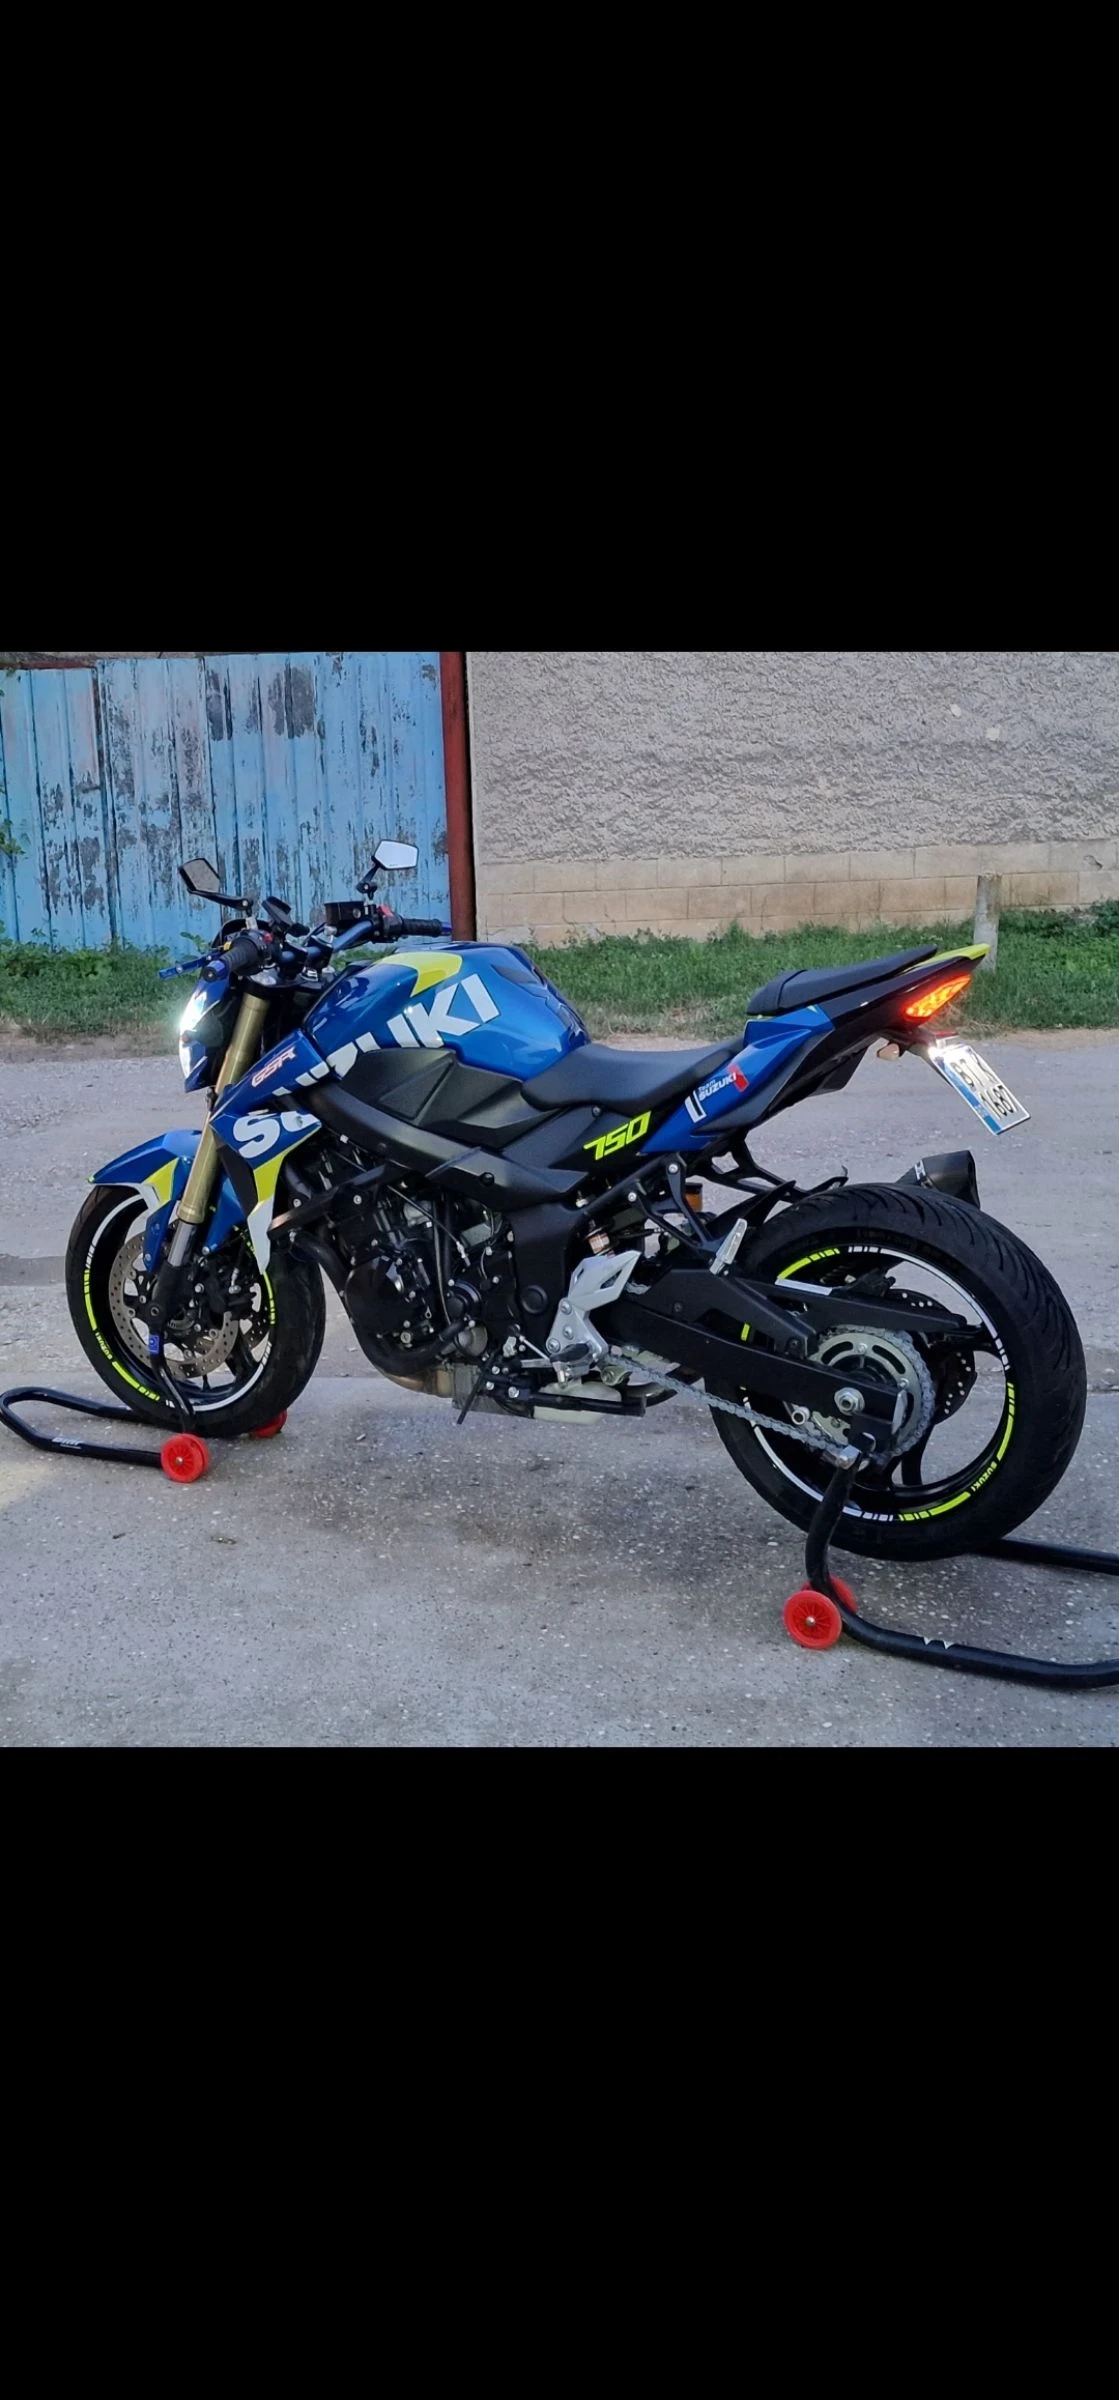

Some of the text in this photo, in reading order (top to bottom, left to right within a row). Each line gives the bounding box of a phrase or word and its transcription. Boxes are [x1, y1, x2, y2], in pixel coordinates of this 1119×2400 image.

[251, 1046, 297, 1088] GSR
[699, 1072, 737, 1101] SUZUKI
[979, 1085, 1018, 1120] 1687
[583, 1110, 652, 1161] 750
[970, 1460, 998, 1492] SUZUKI
